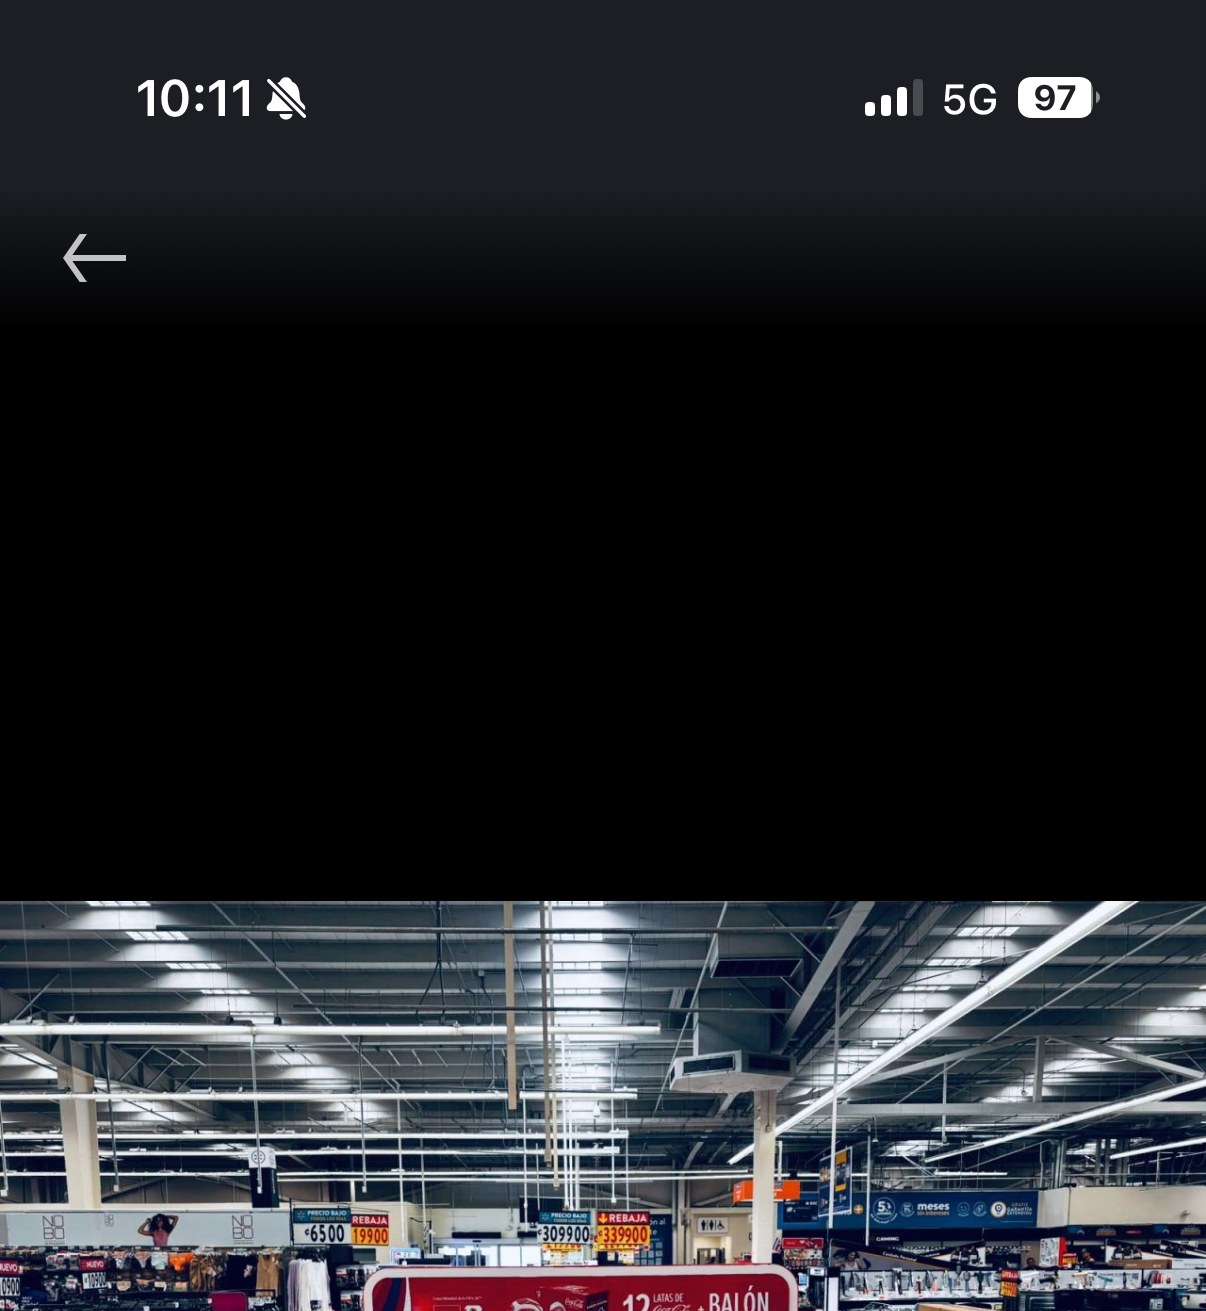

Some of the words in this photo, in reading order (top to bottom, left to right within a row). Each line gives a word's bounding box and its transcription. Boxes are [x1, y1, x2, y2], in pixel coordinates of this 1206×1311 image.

[917, 1203, 950, 1211] meses
[352, 1216, 388, 1225] REBAJA
[609, 1213, 648, 1223] REBAJA
[354, 1228, 388, 1243] 19900
[87, 1260, 105, 1268] NUEVO
[653, 1294, 674, 1303] LATAS
[674, 1293, 684, 1303] DE
